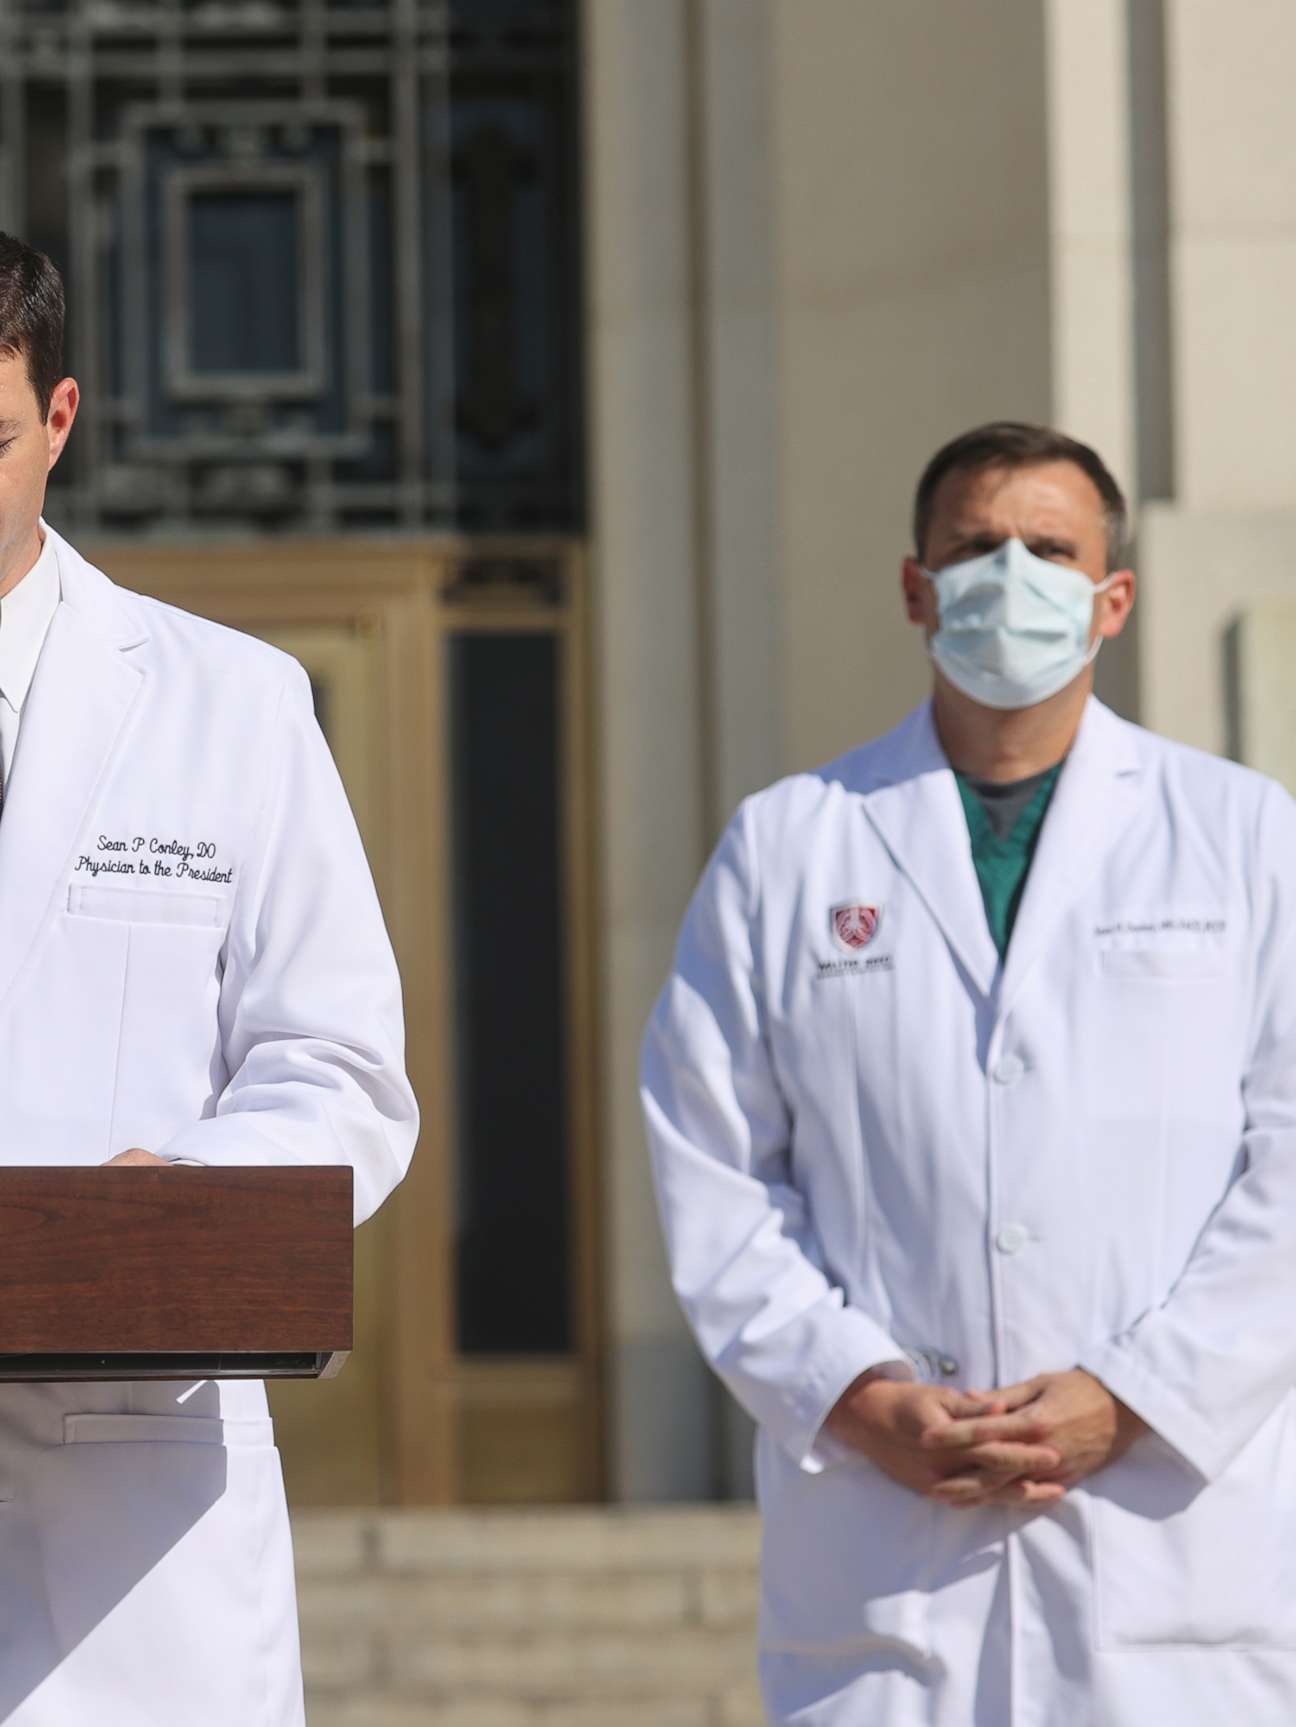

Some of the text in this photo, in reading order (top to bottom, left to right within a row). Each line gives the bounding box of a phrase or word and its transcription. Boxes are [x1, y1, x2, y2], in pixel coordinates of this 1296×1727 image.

[97, 835, 128, 851] Sean
[131, 837, 145, 852] P
[196, 842, 216, 859] DO
[74, 856, 233, 884] Physician to the President
